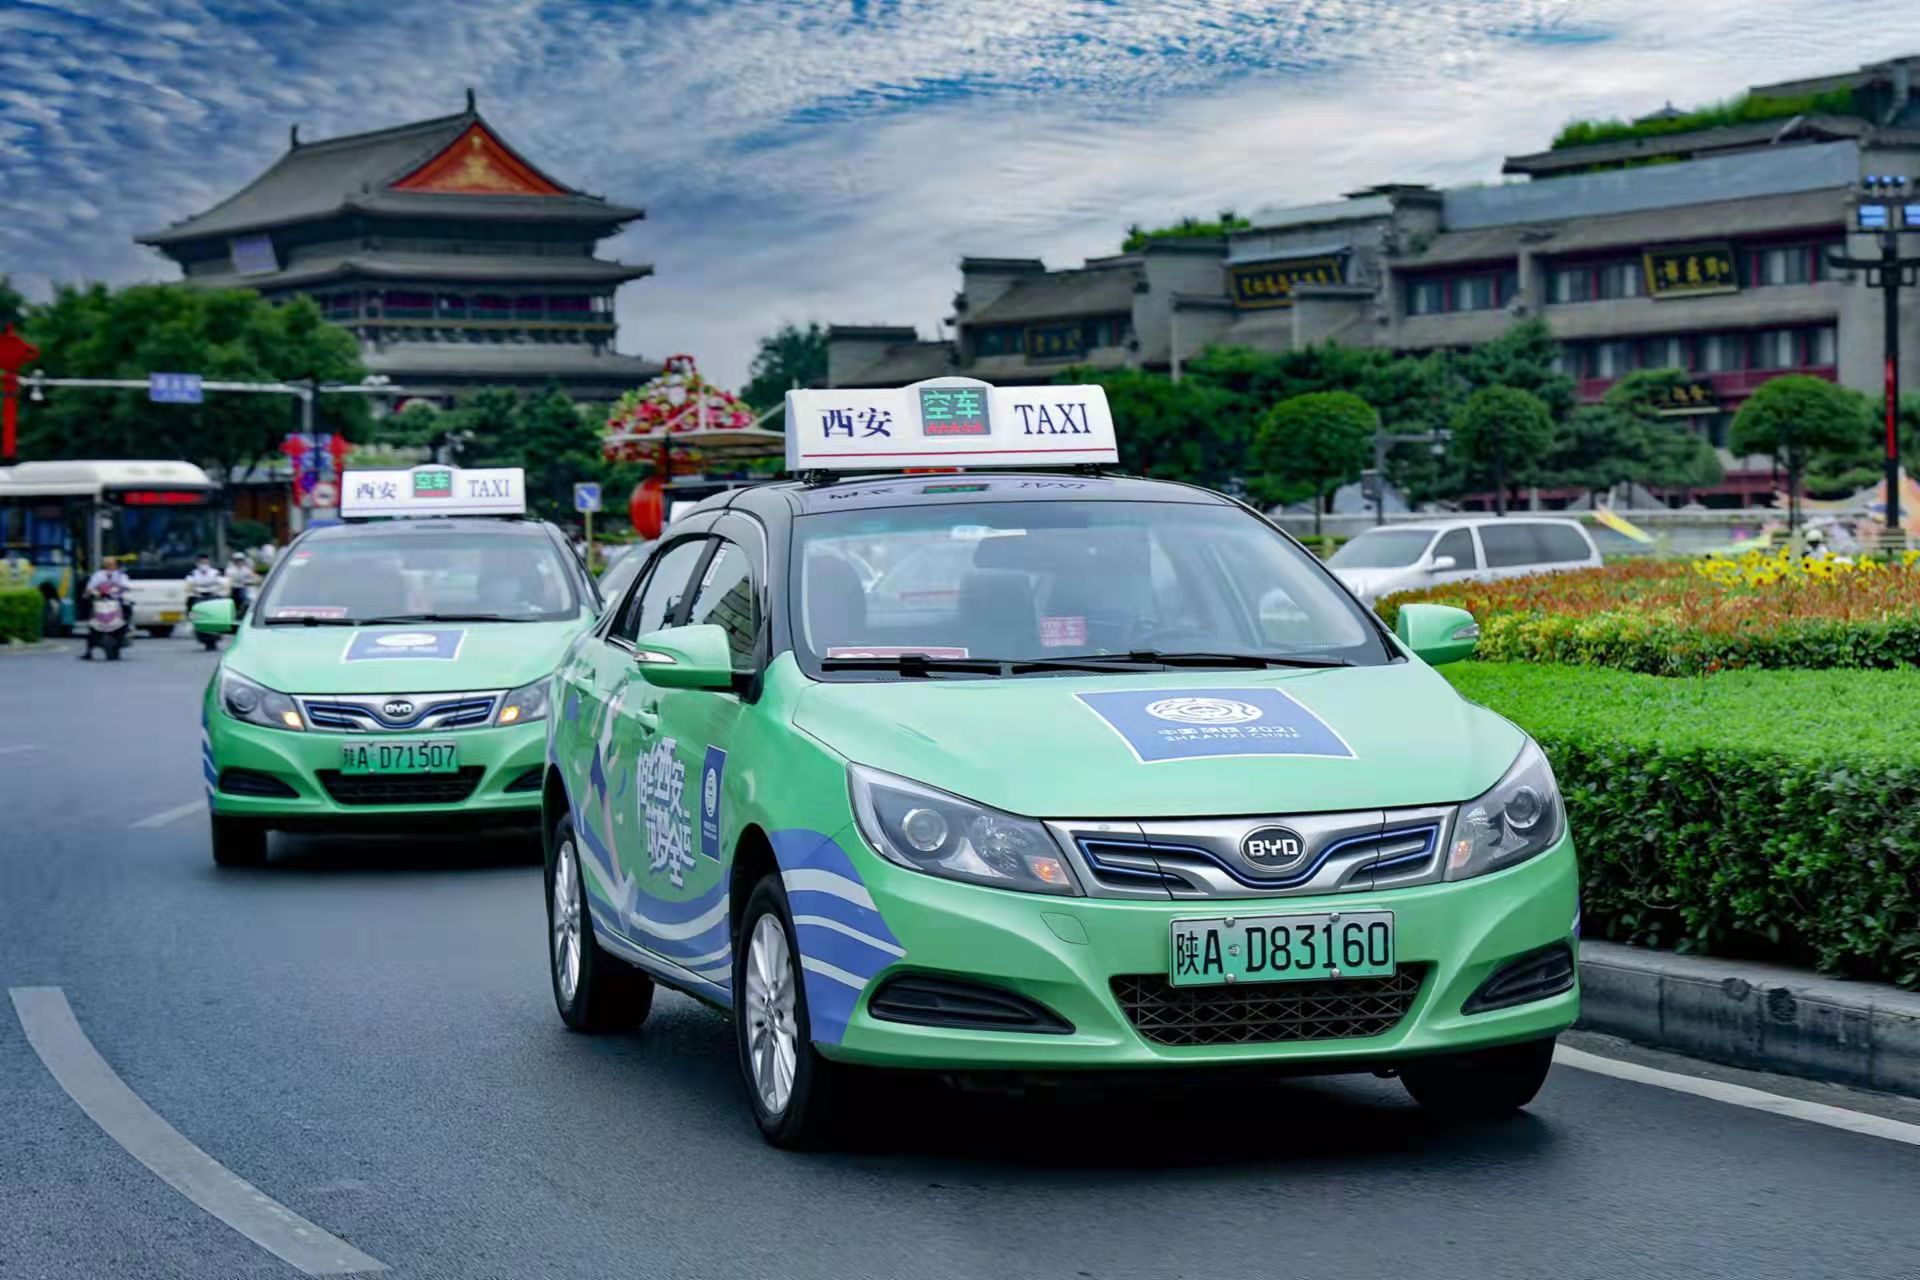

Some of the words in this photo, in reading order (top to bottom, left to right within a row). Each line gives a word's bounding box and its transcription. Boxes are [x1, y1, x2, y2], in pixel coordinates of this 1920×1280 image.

[923, 390, 983, 420] 空车
[819, 407, 894, 438] 西安
[1015, 403, 1092, 435] TAXI
[356, 481, 398, 499] 西安
[468, 479, 510, 497] TAXI
[385, 703, 413, 714] BYD
[1247, 839, 1299, 857] BYD
[1245, 922, 1389, 973] D83160
